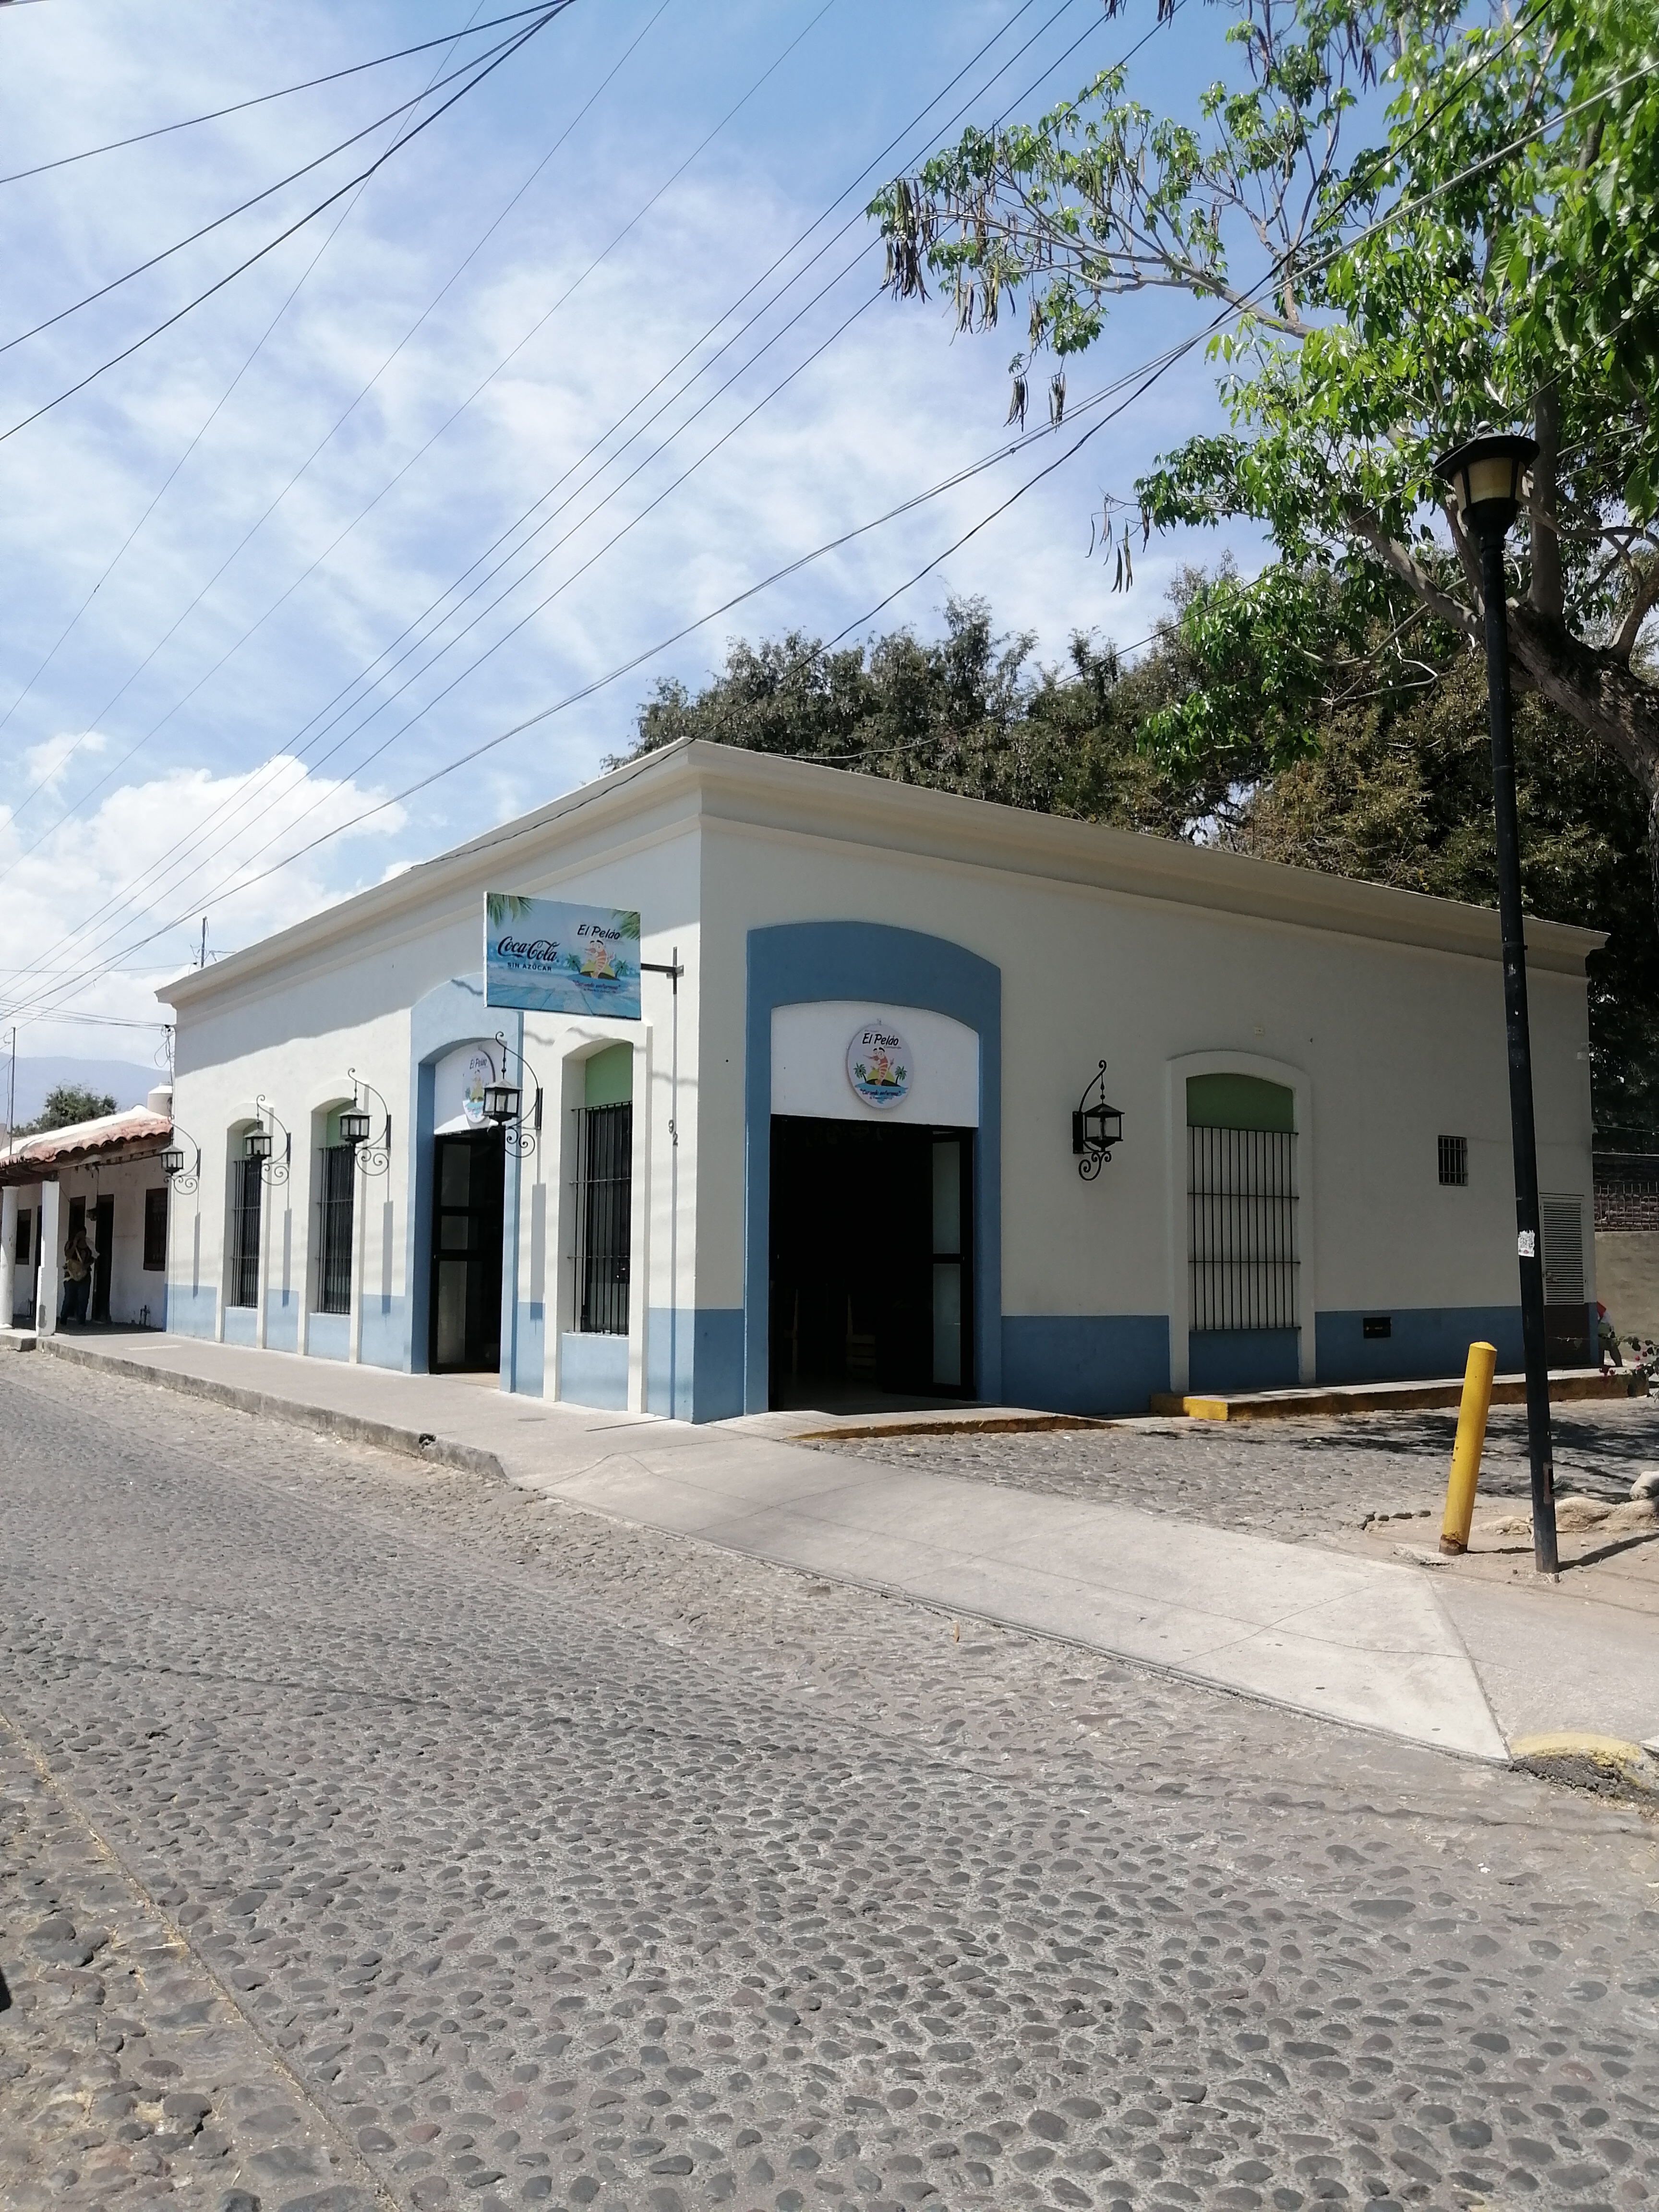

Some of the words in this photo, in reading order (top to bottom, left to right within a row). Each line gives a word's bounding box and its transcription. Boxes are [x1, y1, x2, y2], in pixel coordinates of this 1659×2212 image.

[577, 924, 590, 936] El
[591, 926, 621, 940] Peláo
[497, 936, 561, 962] Coca-Cola
[522, 962, 552, 972] AZÚCAR
[862, 1033, 873, 1044] El
[874, 1034, 899, 1046] Peláo
